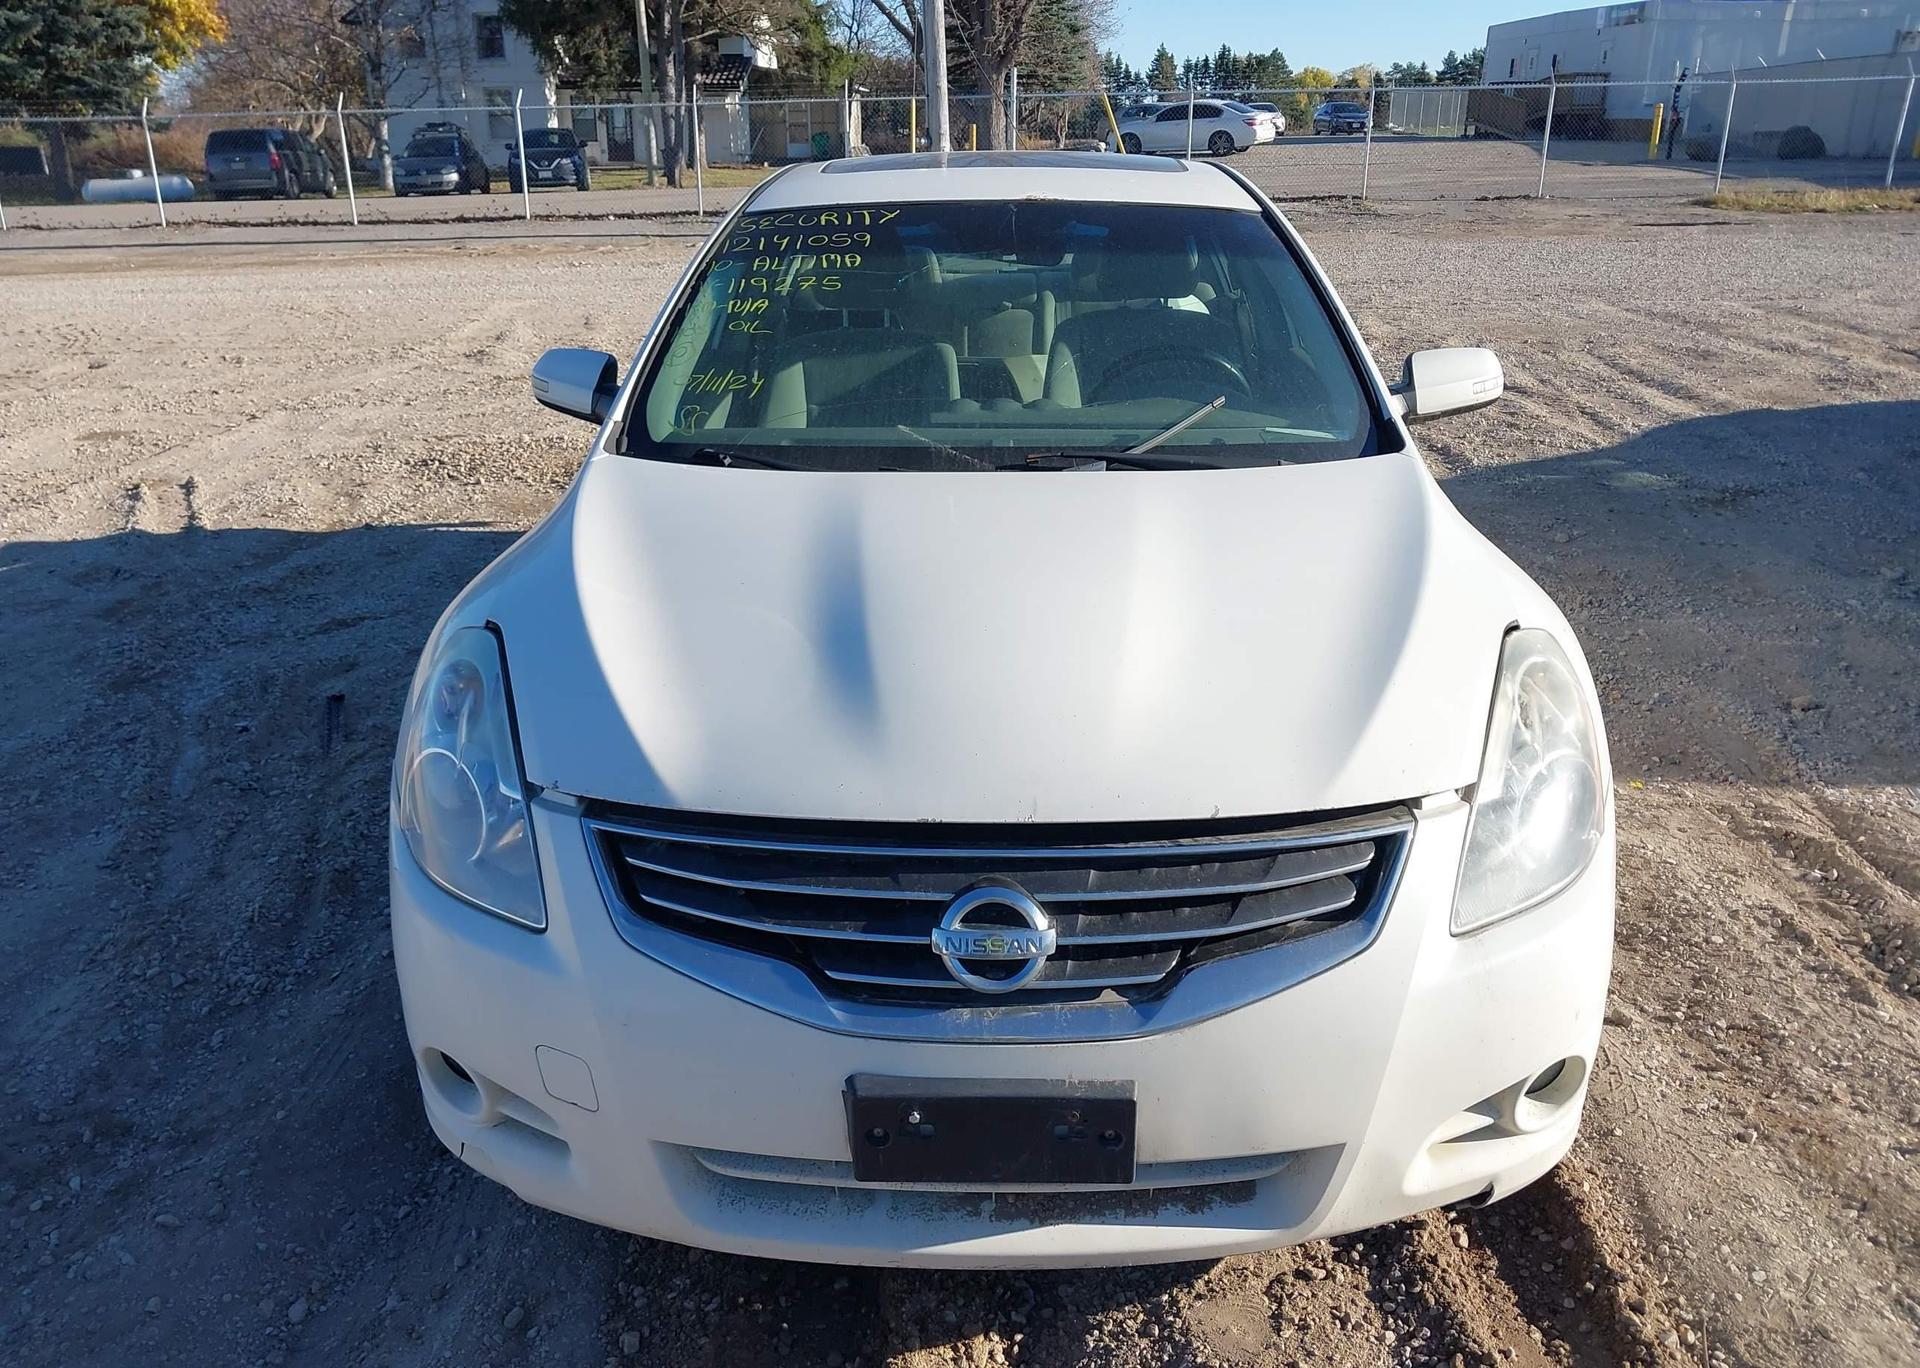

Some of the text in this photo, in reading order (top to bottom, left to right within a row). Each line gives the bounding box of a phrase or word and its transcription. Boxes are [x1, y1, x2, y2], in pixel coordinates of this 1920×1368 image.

[737, 210, 900, 233] SECURITY
[753, 253, 862, 272] ALTIMA
[944, 936, 1043, 955] NISSAN
